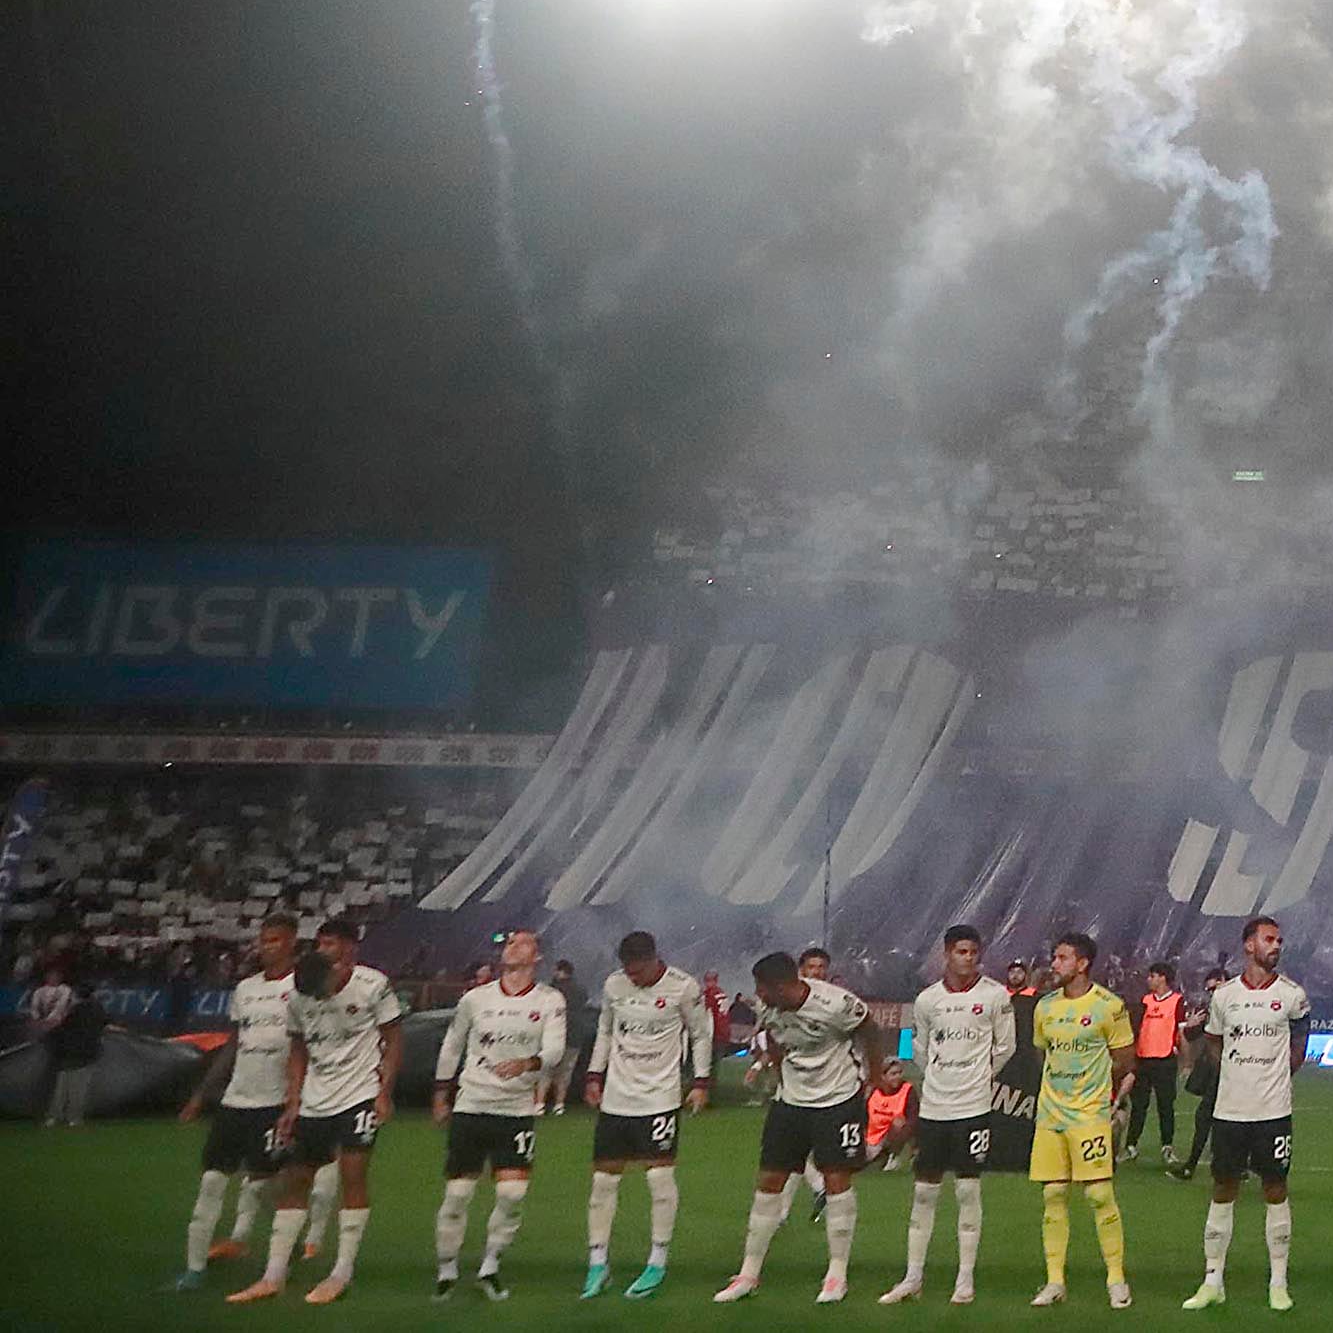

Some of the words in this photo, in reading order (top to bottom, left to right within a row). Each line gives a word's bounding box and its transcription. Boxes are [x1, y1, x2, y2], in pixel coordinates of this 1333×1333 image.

[25, 585, 467, 659] LIBERTY
[1245, 1023, 1278, 1037] kolbi
[652, 1116, 675, 1142] 24
[839, 1123, 860, 1147] 13
[969, 1129, 990, 1155] 28
[1081, 1136, 1107, 1162] 23
